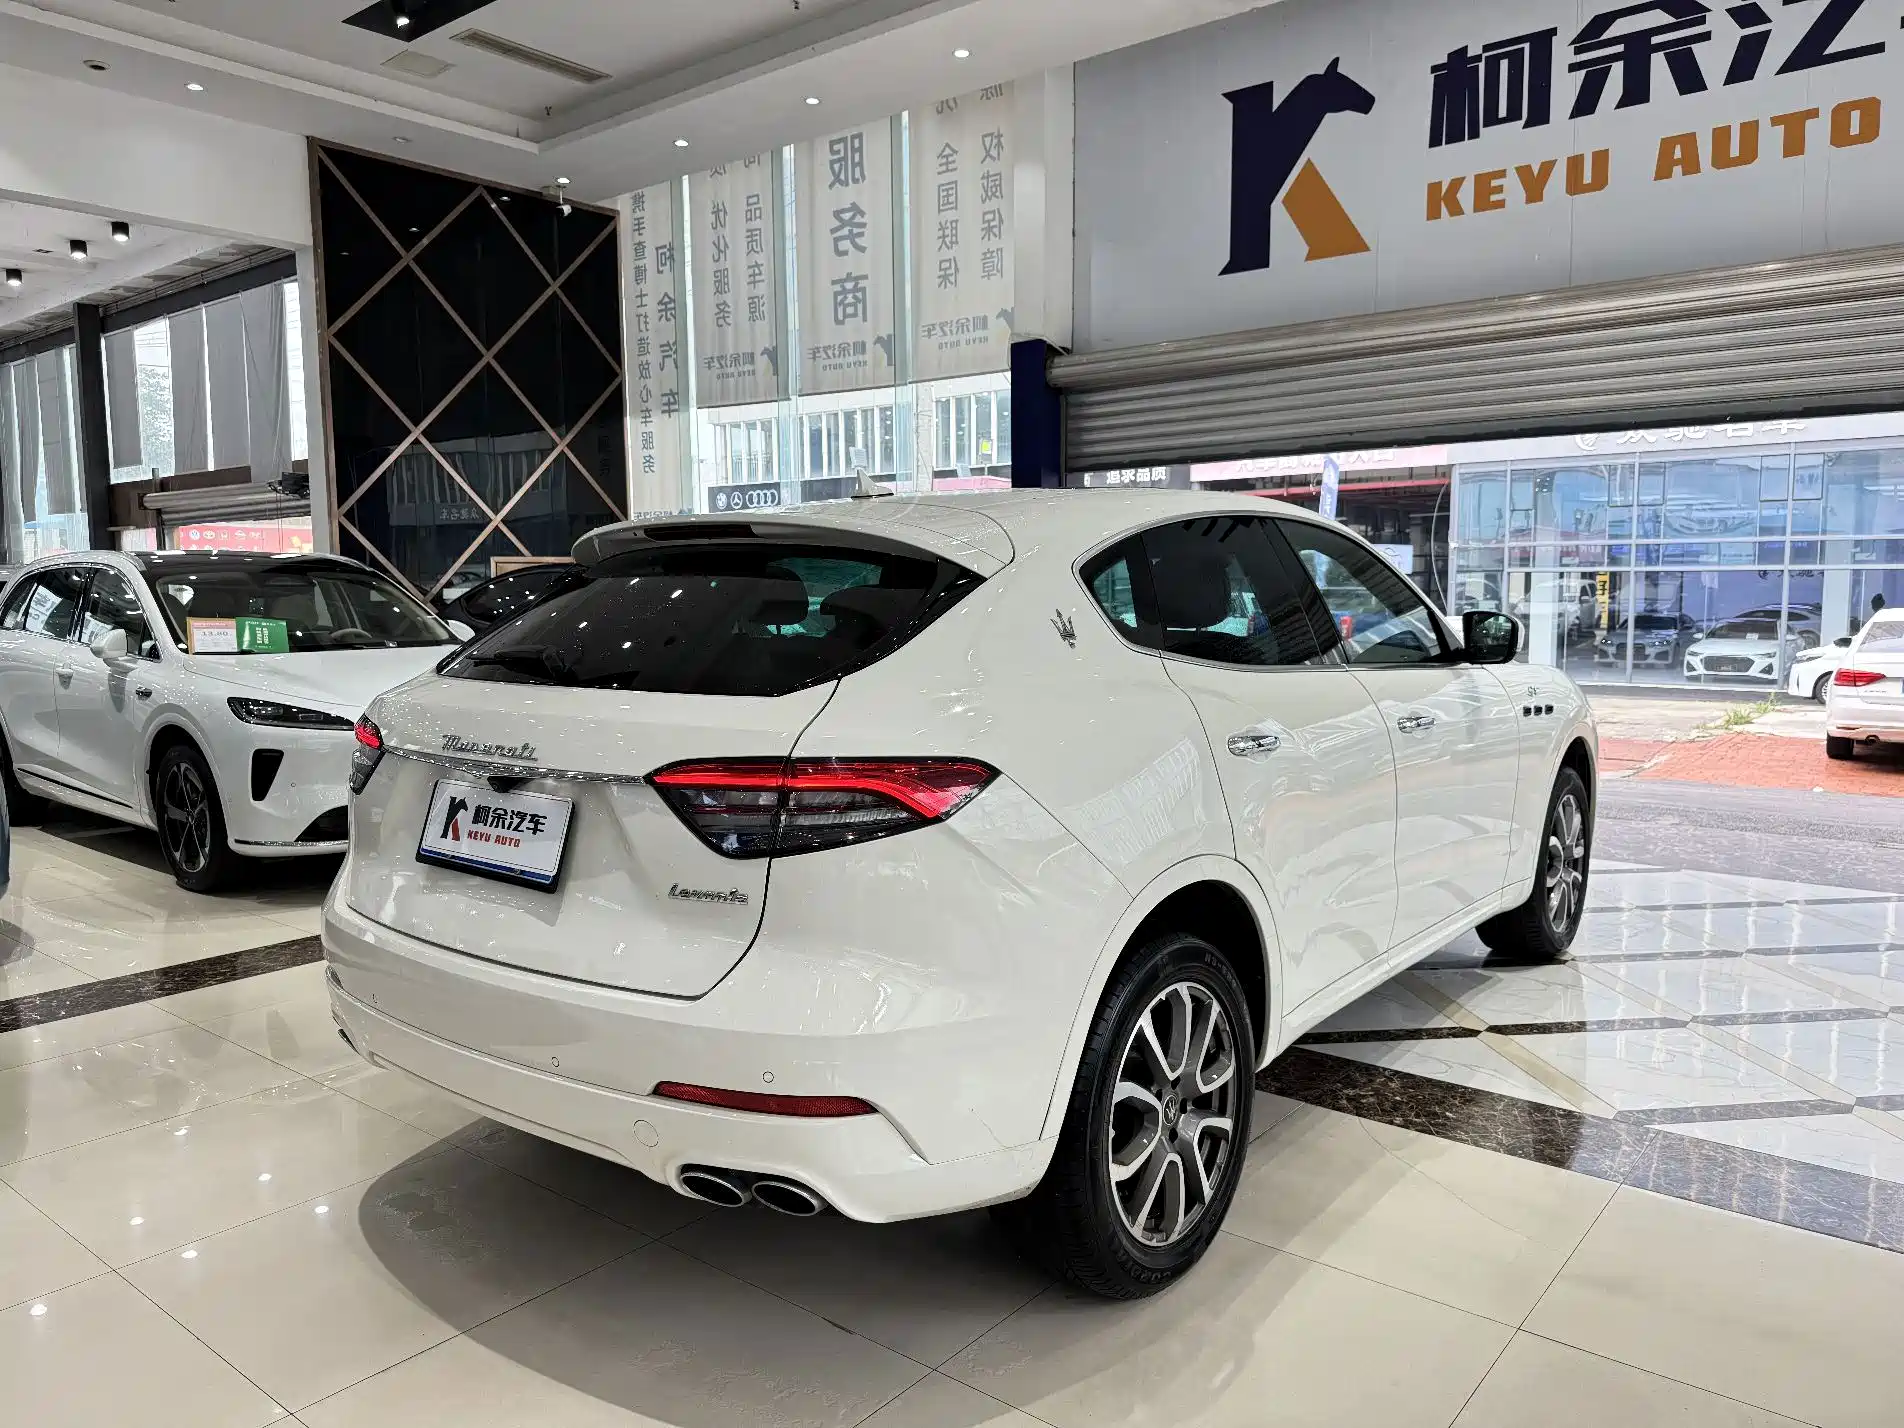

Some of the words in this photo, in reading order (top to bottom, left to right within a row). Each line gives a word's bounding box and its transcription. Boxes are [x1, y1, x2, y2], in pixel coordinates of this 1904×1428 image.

[1428, 0, 1904, 149] 柯余汽
[1425, 148, 1610, 221] KEYU
[1653, 96, 1882, 181] AUTO
[442, 734, 539, 762] Maserati
[471, 804, 548, 836] 柯余汽车
[467, 829, 491, 843] KEYU
[494, 834, 521, 848] AUTO
